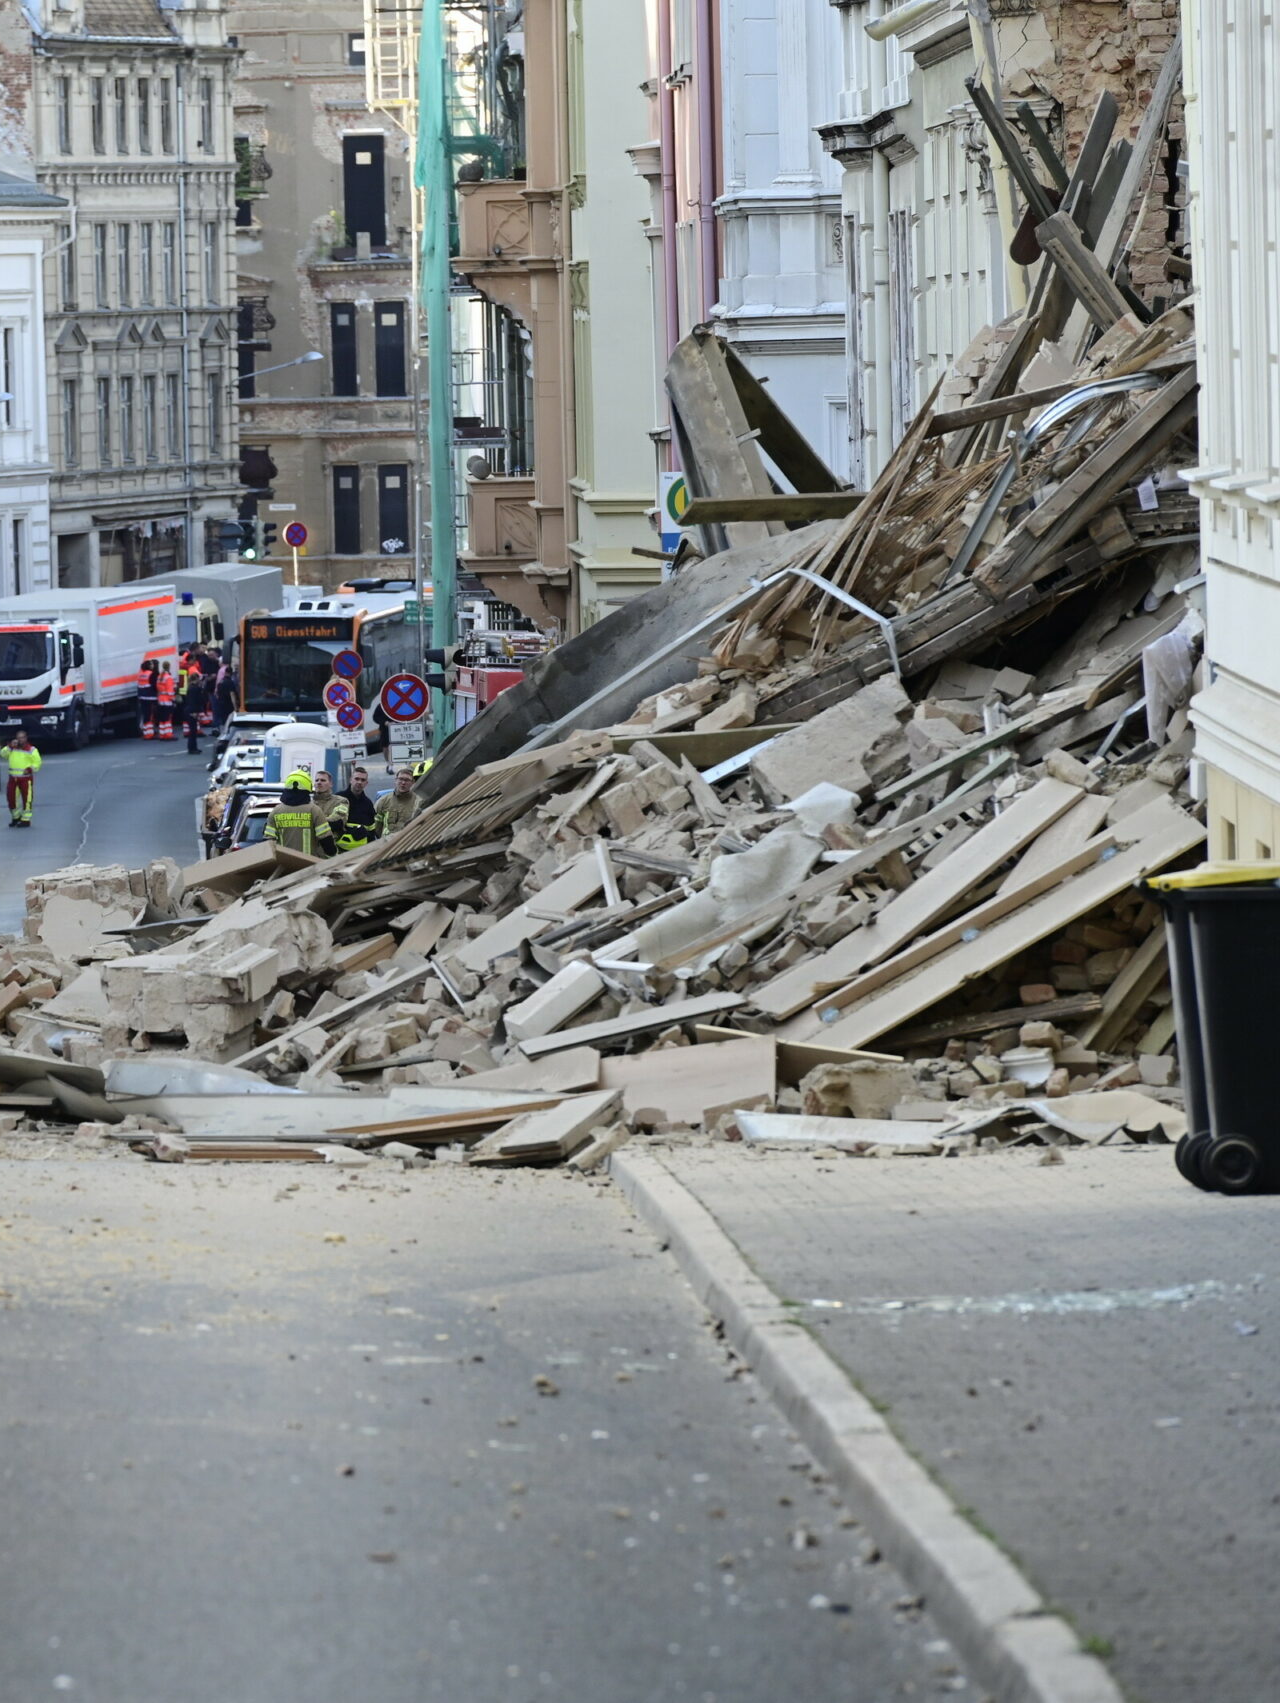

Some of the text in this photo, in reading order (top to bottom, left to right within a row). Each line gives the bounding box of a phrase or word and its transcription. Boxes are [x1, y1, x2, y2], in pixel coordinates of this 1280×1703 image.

[275, 625, 337, 637] Dienstfahrt
[274, 812, 312, 821] FREIWILLIGE
[275, 820, 311, 828] FEUERWEHR
